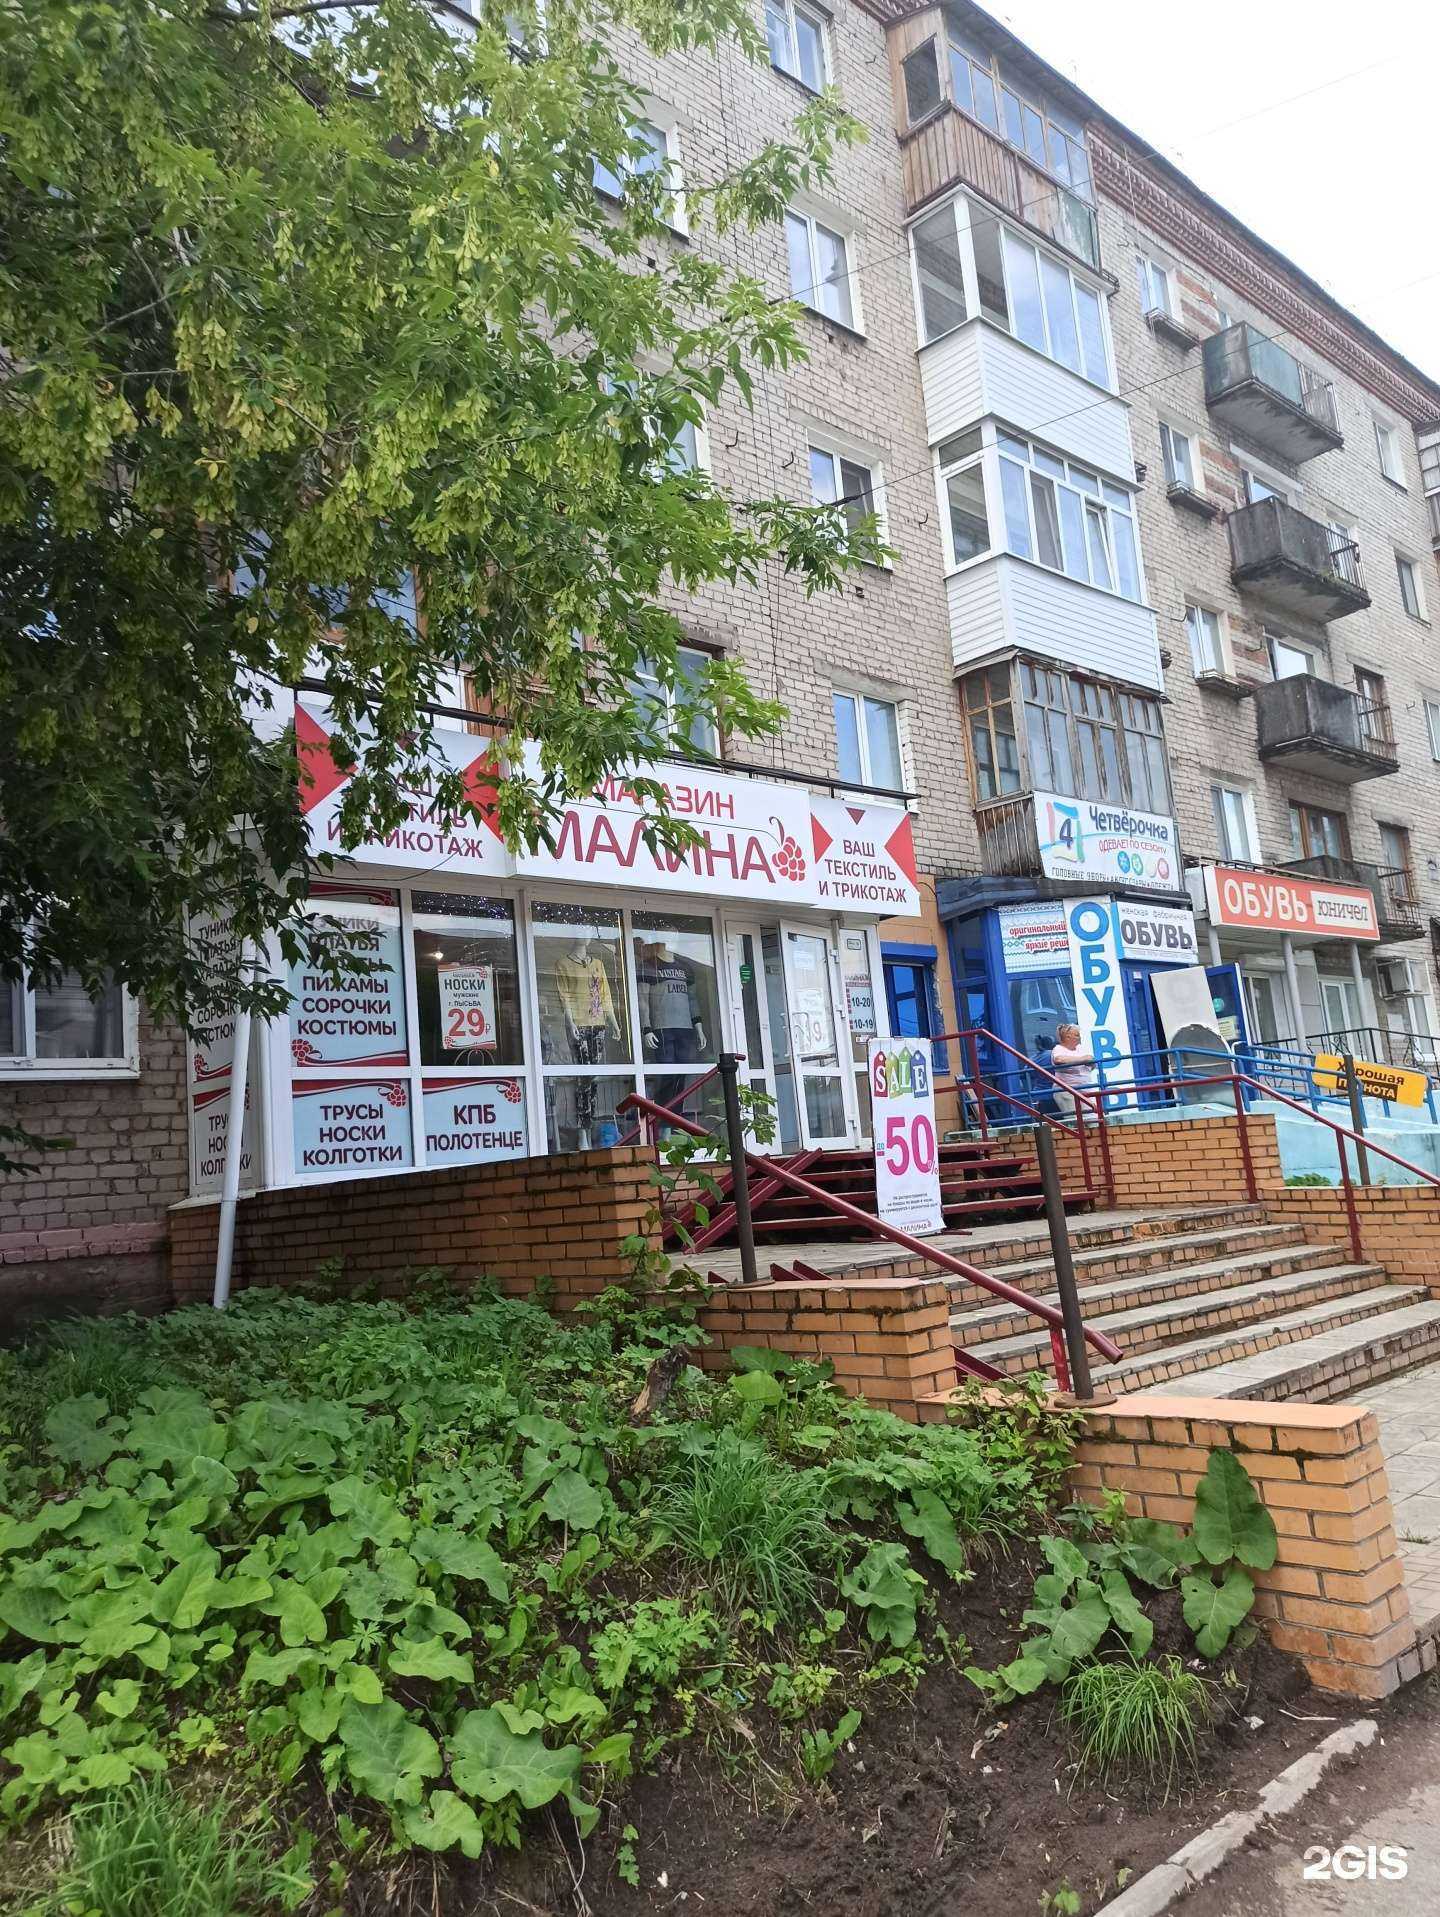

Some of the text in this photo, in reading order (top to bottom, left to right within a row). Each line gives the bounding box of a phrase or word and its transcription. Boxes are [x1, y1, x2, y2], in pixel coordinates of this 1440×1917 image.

[1060, 818, 1073, 848] 4
[1089, 805, 1169, 839] Четвёрочка
[843, 839, 875, 857] ВАШ
[825, 858, 896, 881] ТЕКСТИЛЬ
[818, 880, 907, 903] И ТРИКОТАЖ
[1223, 879, 1308, 923] ОБУВЬ
[1120, 919, 1193, 949] ОБУВЬ
[1025, 940, 1048, 952] яркие
[302, 975, 389, 994] ПИЖАМЫ
[444, 978, 486, 991] НОСКИ
[301, 997, 392, 1015] СОРОЧКИ
[851, 997, 872, 1009] 10-20
[1070, 901, 1128, 1110] ОБУВЬ
[297, 1019, 397, 1036] КОСТЮМЫ
[448, 1008, 485, 1037] 29
[853, 1018, 875, 1030] 10-19
[875, 1060, 929, 1094] SALE
[1337, 1061, 1405, 1086] Хрошая
[1338, 1077, 1396, 1099] ПНОТА
[320, 1103, 384, 1121] ТРУСЫ
[453, 1103, 497, 1126] КПБ
[319, 1125, 387, 1144] НОСКИ
[426, 1130, 524, 1152] ПОЛОТЕНЦЕ
[303, 1146, 403, 1167] КОЛГОТКИ
